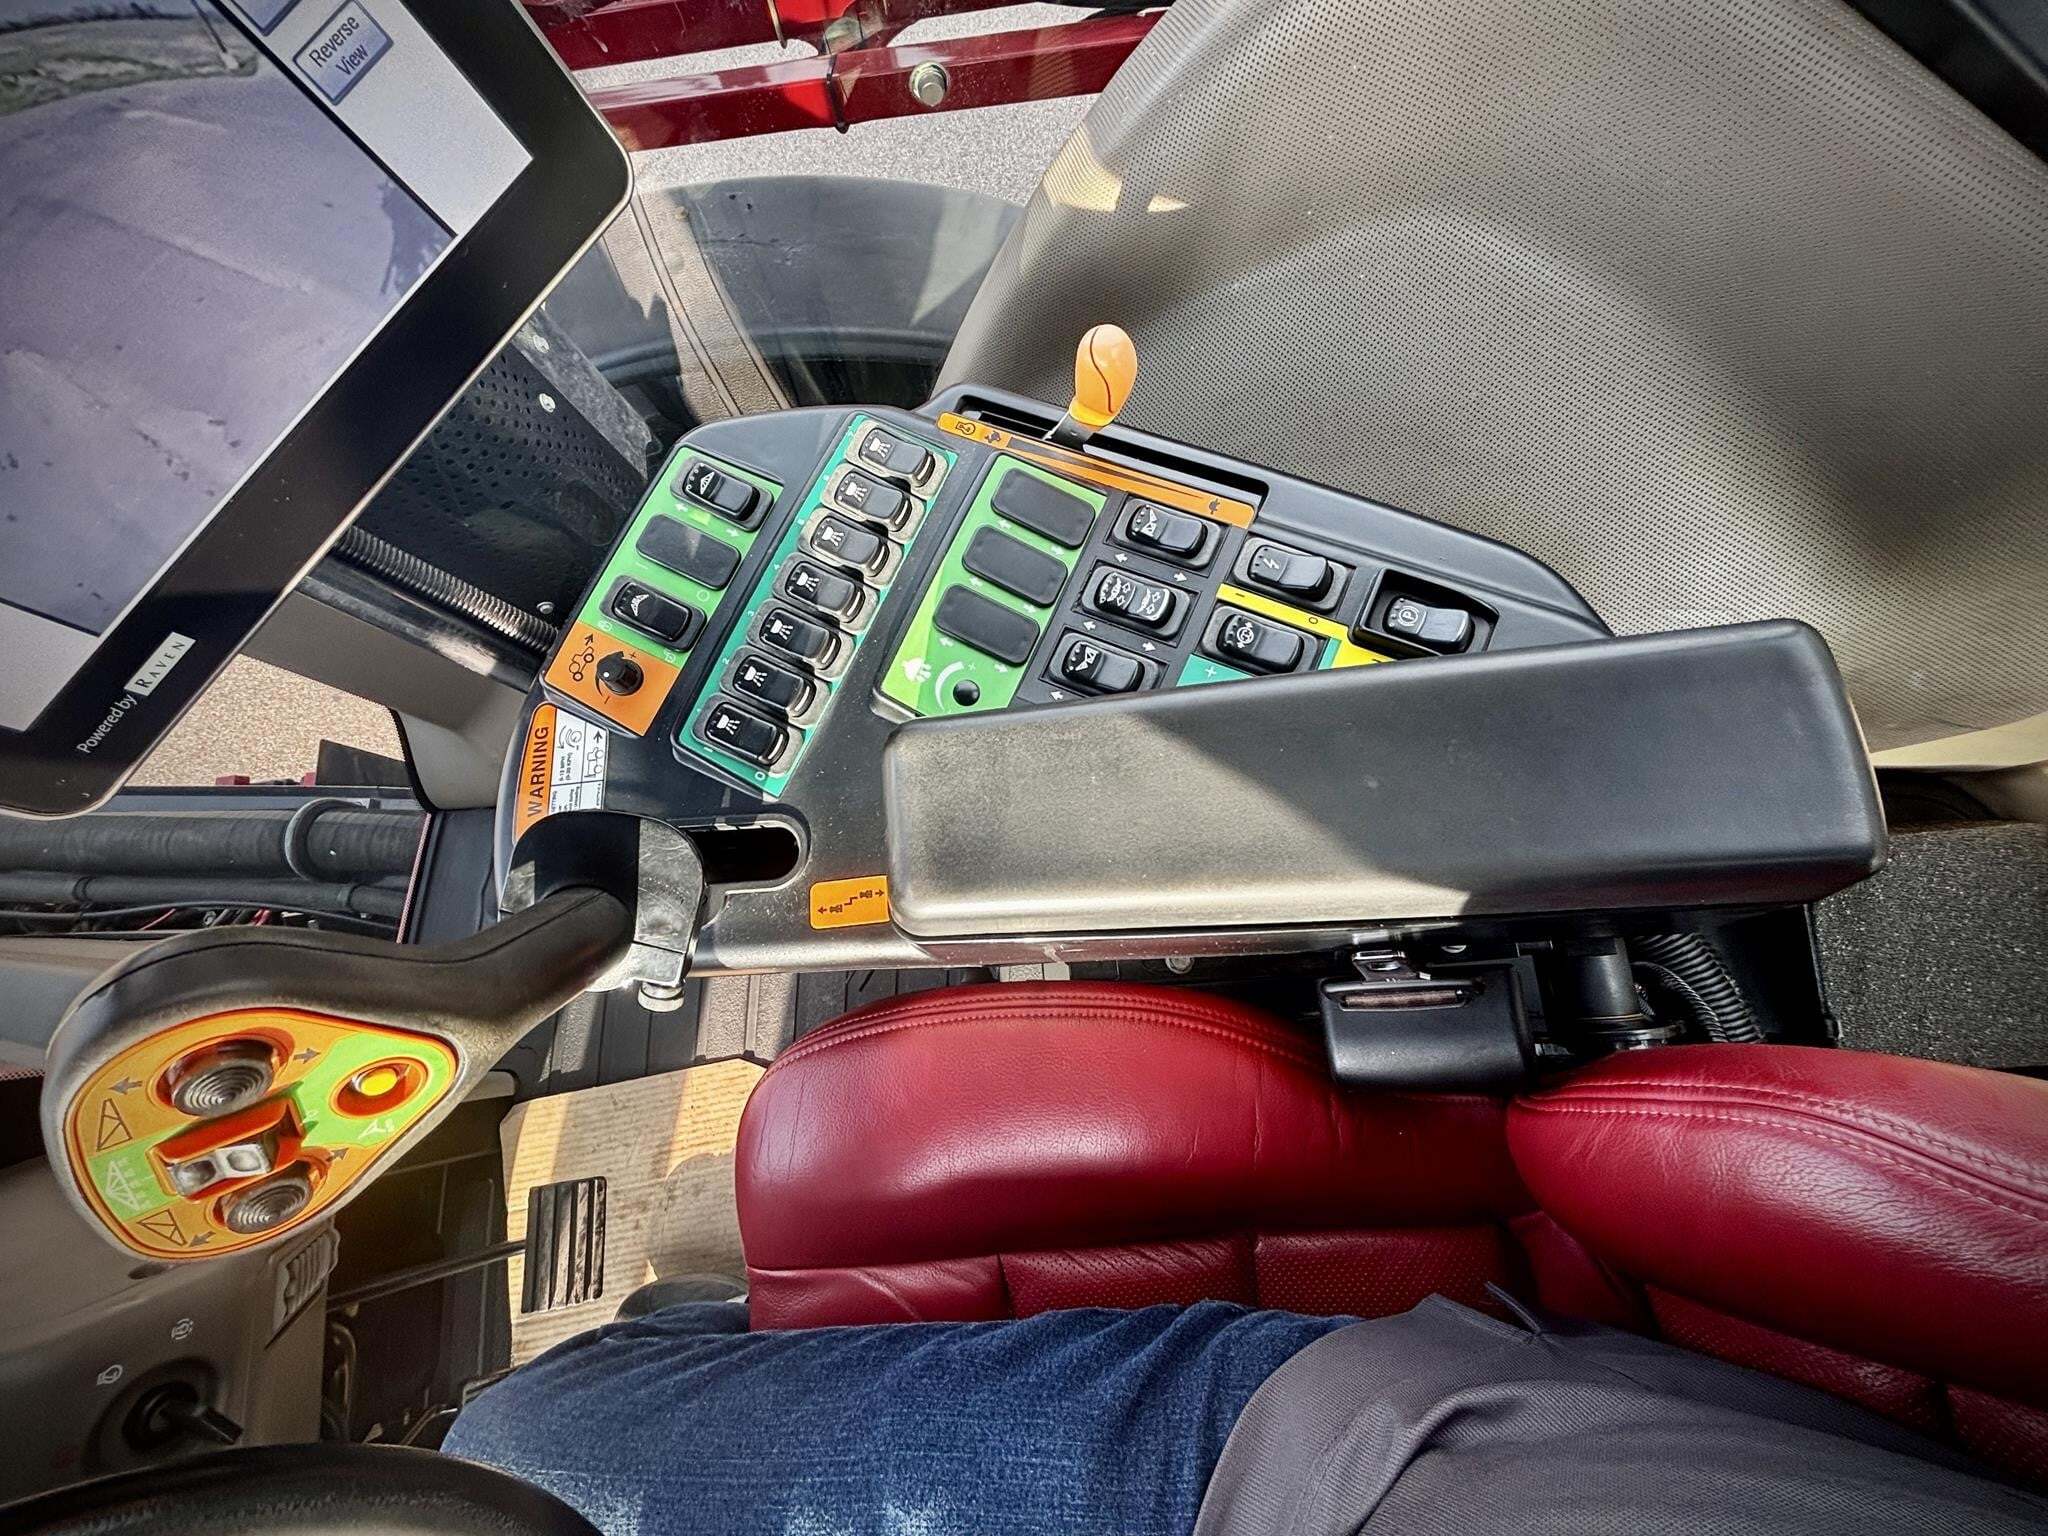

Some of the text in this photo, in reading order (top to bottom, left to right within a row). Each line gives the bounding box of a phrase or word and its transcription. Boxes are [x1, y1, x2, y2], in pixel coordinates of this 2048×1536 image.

[309, 16, 360, 68] Reverse
[336, 44, 369, 75] View
[76, 641, 186, 754] Powered by RAVEN
[527, 726, 549, 818] WARNING
